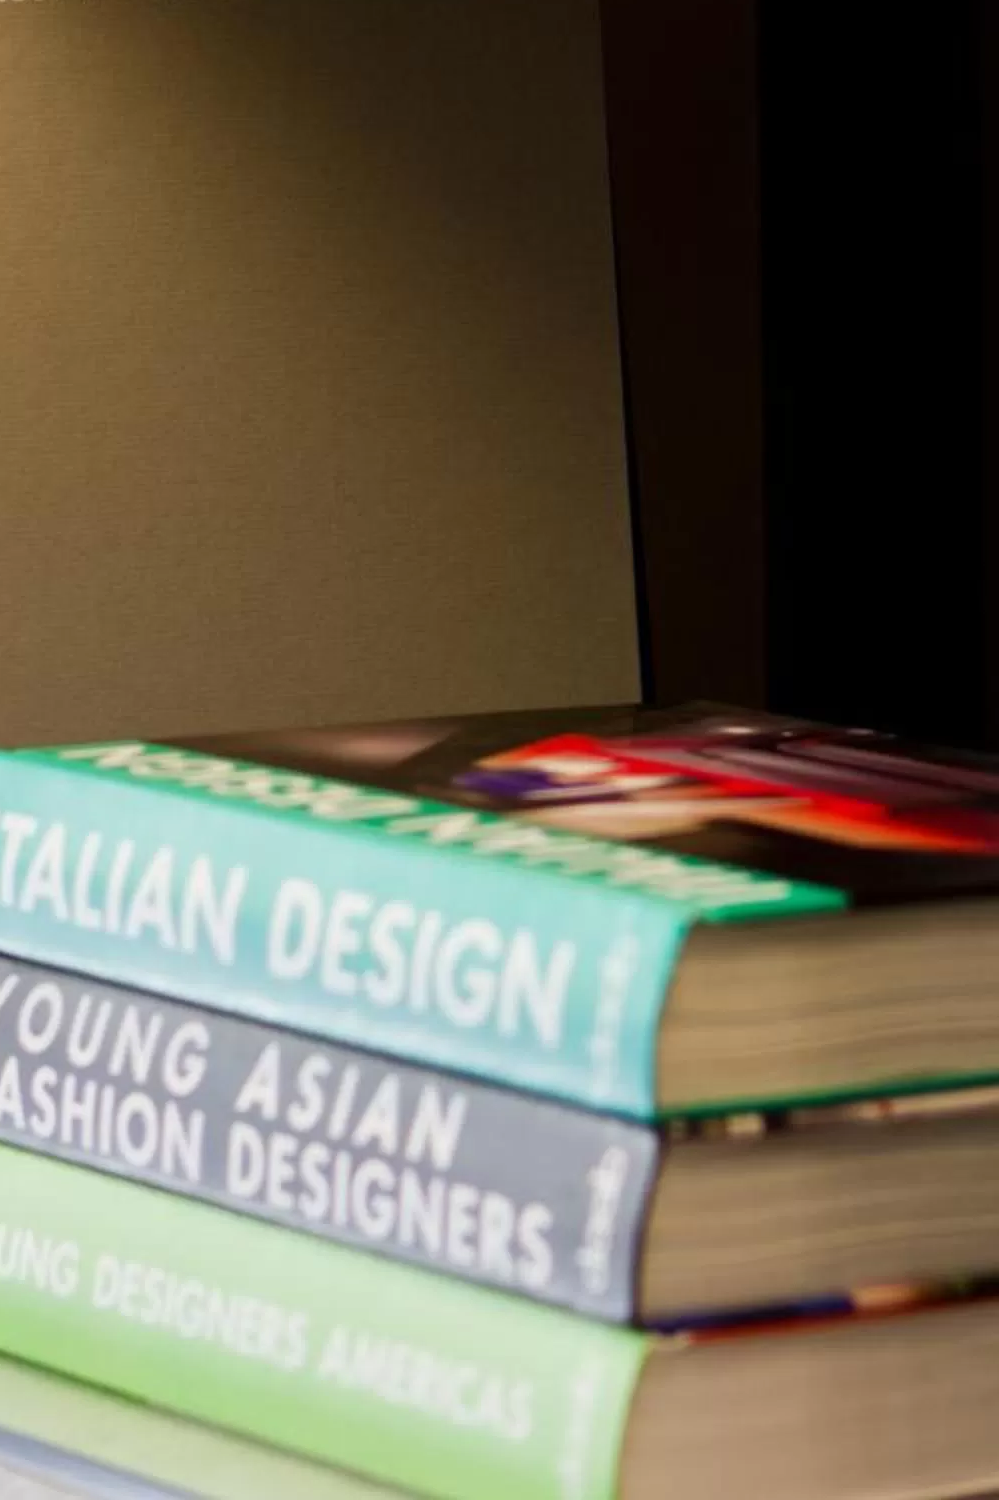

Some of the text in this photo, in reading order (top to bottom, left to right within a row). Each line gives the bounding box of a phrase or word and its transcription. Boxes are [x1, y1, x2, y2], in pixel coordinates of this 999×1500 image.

[270, 877, 576, 1052] DESIGN
[237, 1053, 467, 1172] ASIAN
[227, 1131, 557, 1286] DESIGNERS
[91, 1253, 311, 1372] DESIGNERS
[319, 1323, 536, 1442] AMERICAS
